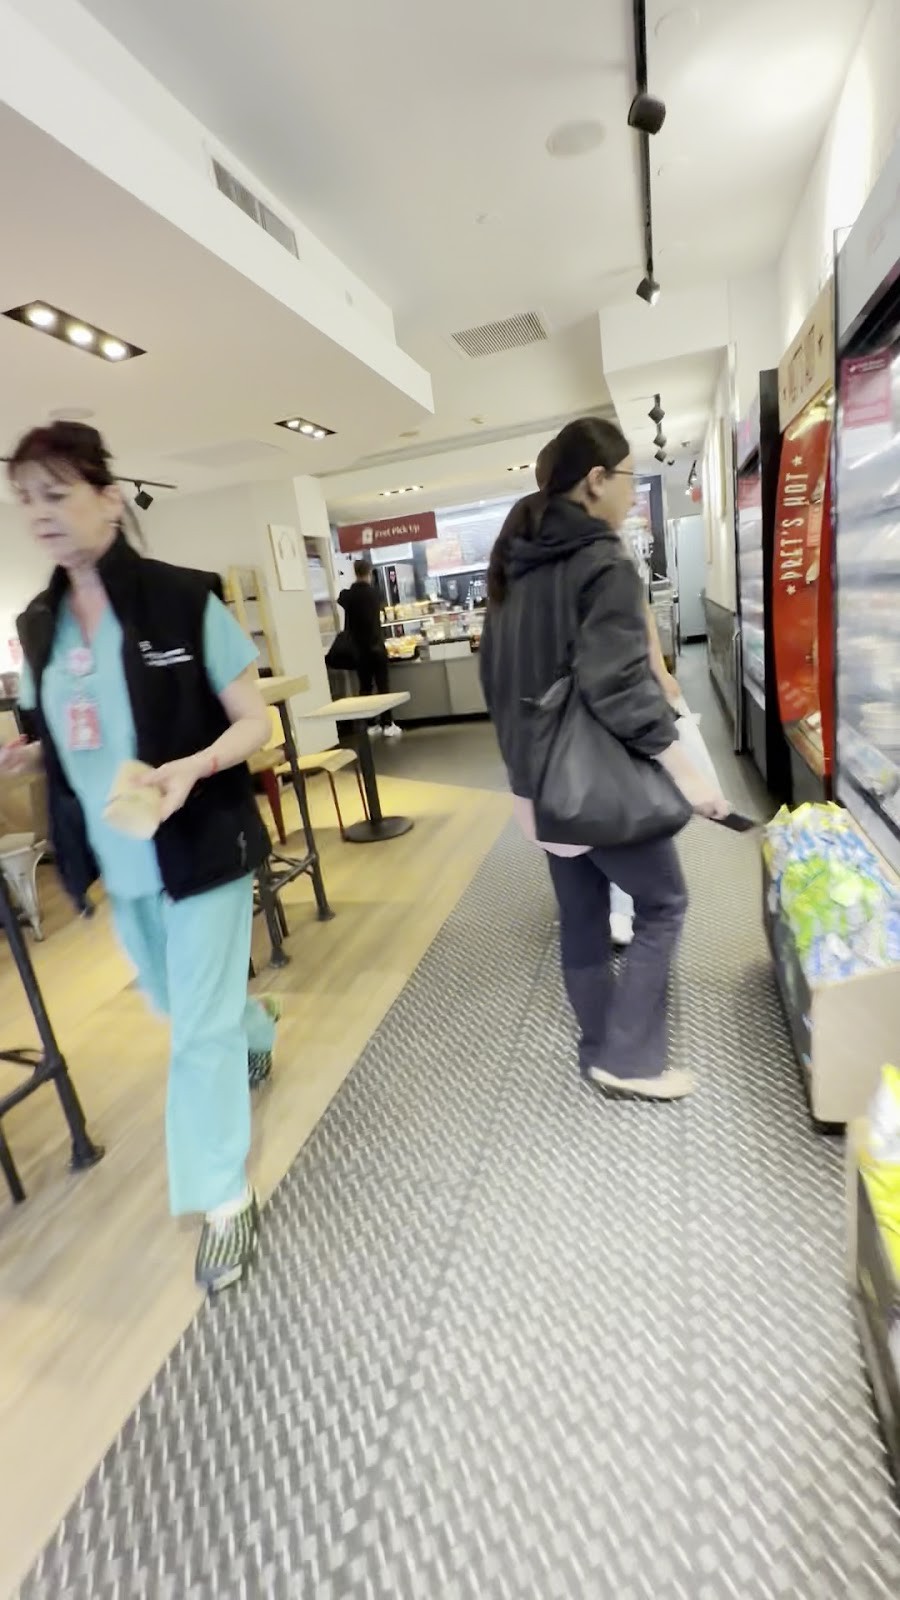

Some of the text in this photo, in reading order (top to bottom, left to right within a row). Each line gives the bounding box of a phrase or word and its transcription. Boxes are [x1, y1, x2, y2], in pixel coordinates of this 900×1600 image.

[391, 525, 407, 537] Pick
[780, 473, 808, 580] PRET'S HOT
